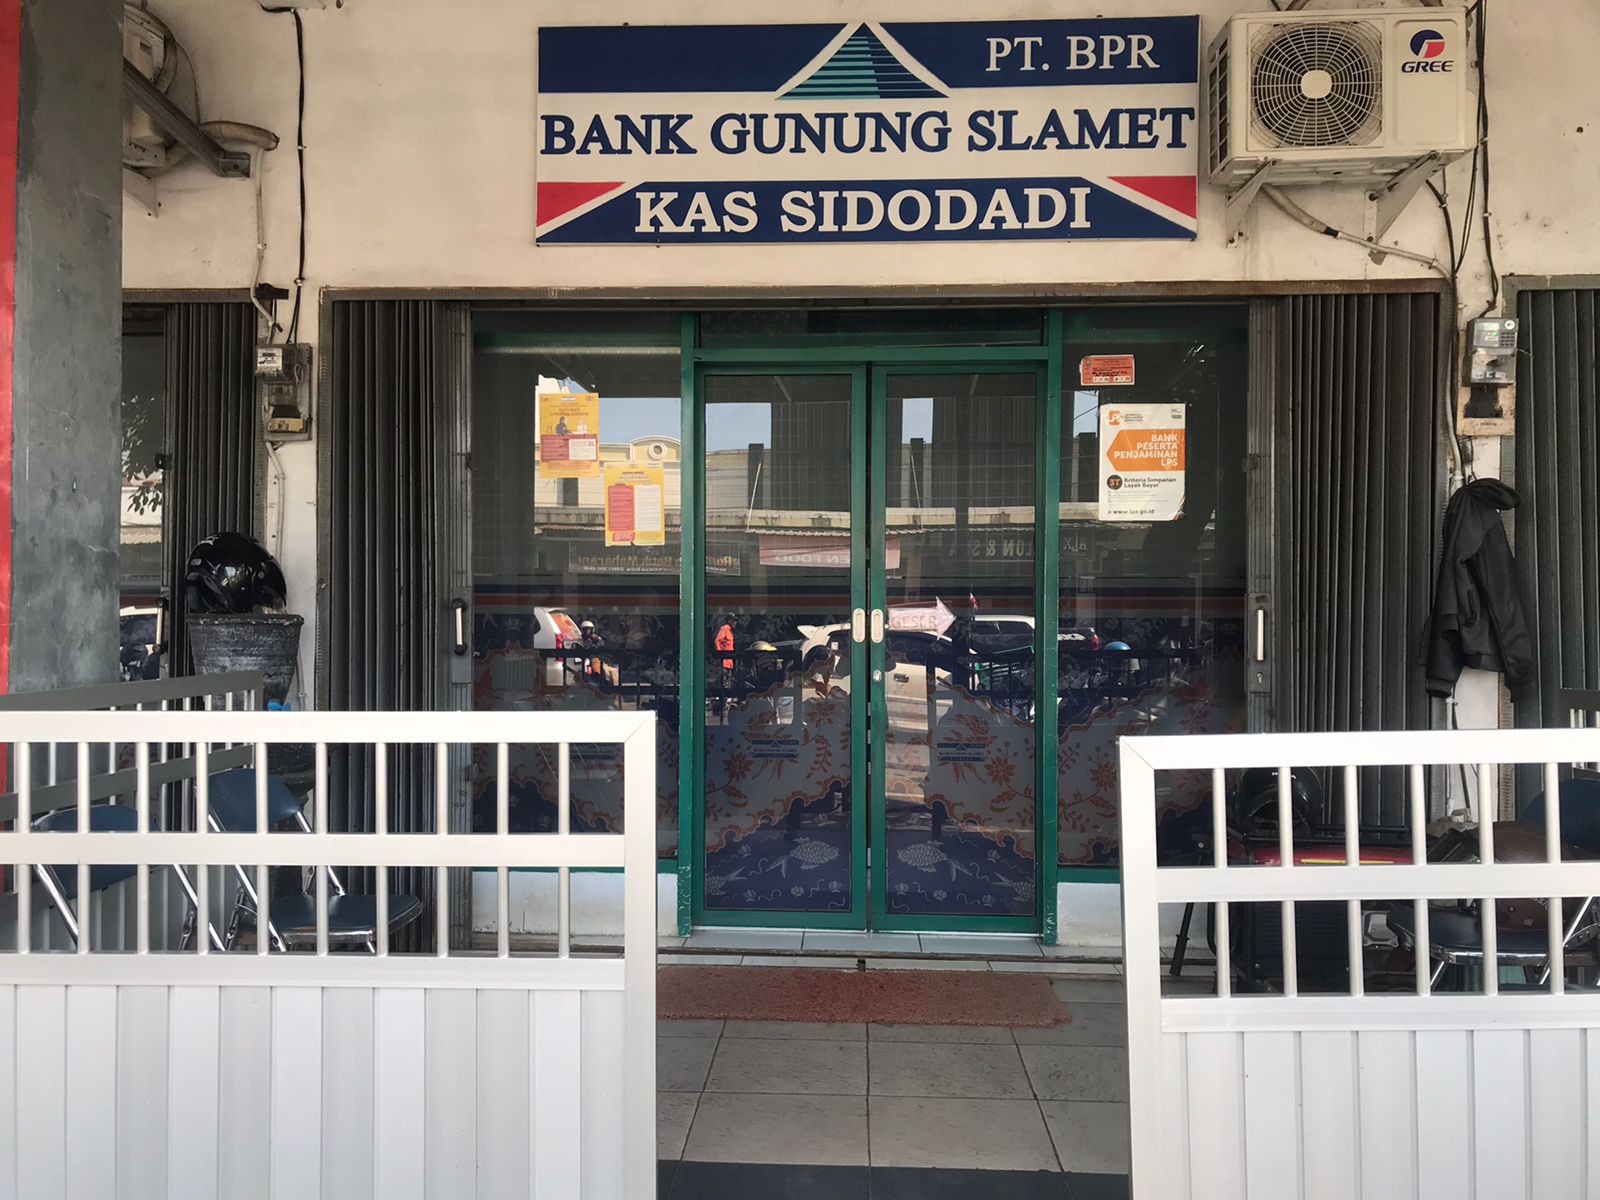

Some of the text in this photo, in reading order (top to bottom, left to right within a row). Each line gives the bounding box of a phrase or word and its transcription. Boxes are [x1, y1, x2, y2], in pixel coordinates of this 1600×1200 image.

[985, 34, 1160, 72] PT. BPR
[1401, 60, 1454, 73] GREE
[539, 107, 1195, 155] BANK GUNUNG SLAMET
[634, 187, 1092, 233] KAS SIDODADI
[1151, 434, 1178, 442] BANK
[1136, 442, 1178, 450] PESERTA
[1113, 450, 1178, 459] PENJAMINAN
[1161, 459, 1178, 467] LPS
